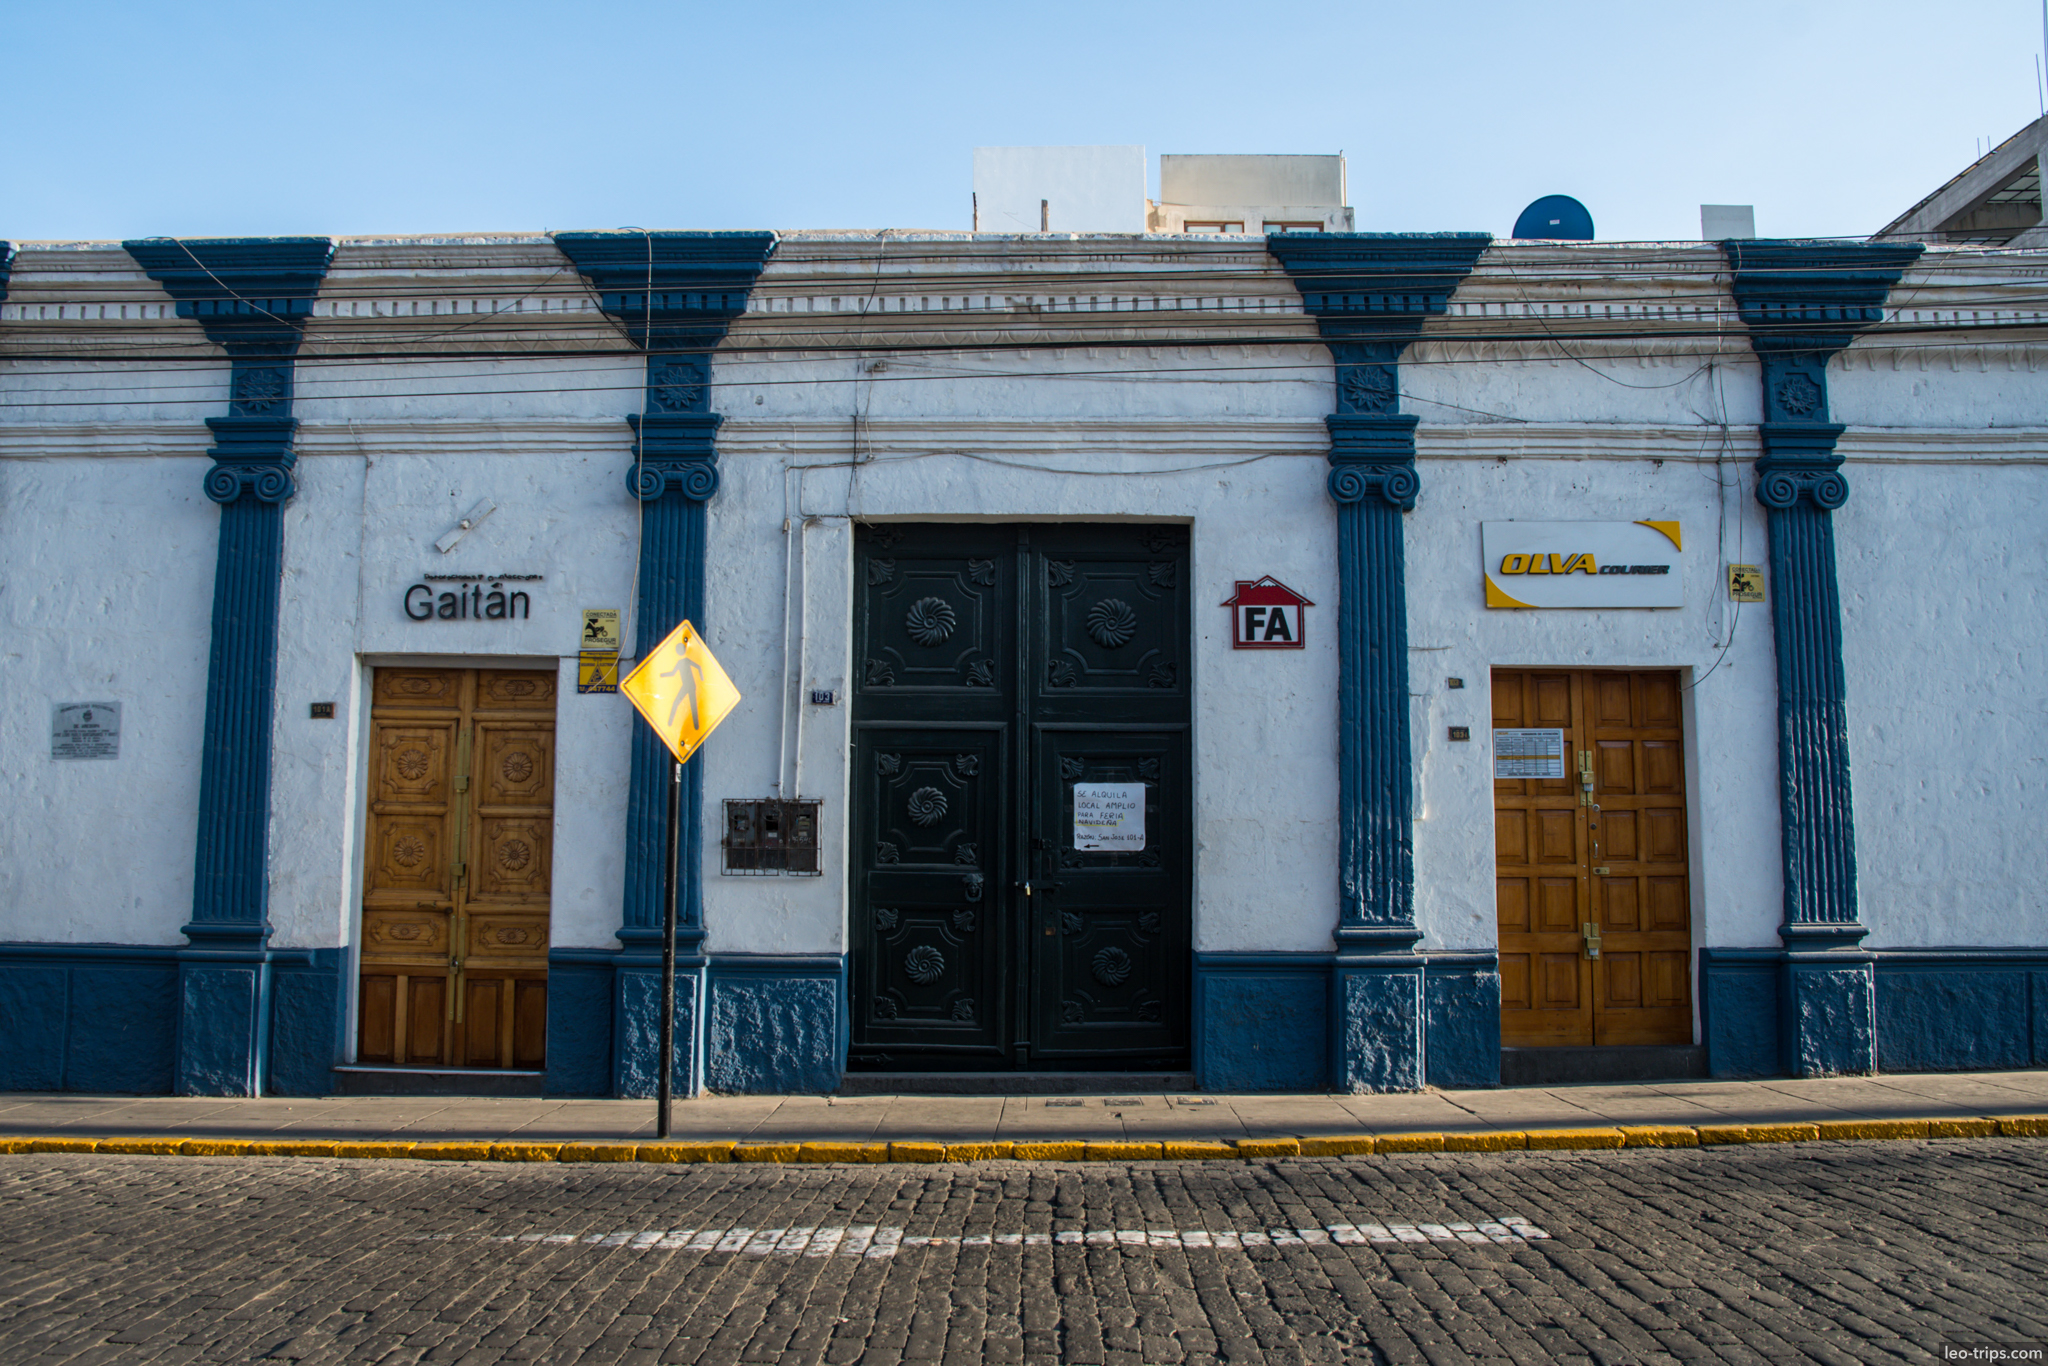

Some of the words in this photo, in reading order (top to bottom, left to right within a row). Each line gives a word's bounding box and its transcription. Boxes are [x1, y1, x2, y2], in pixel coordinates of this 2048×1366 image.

[1500, 553, 1598, 575] OLVA
[1599, 565, 1671, 575] COURIER
[404, 582, 530, 621] Gaitán
[1245, 607, 1292, 641] FA
[815, 691, 830, 701] 103
[1077, 790, 1086, 798] SE
[1091, 790, 1128, 799] ALQUILA
[1100, 812, 1124, 820] FERIA
